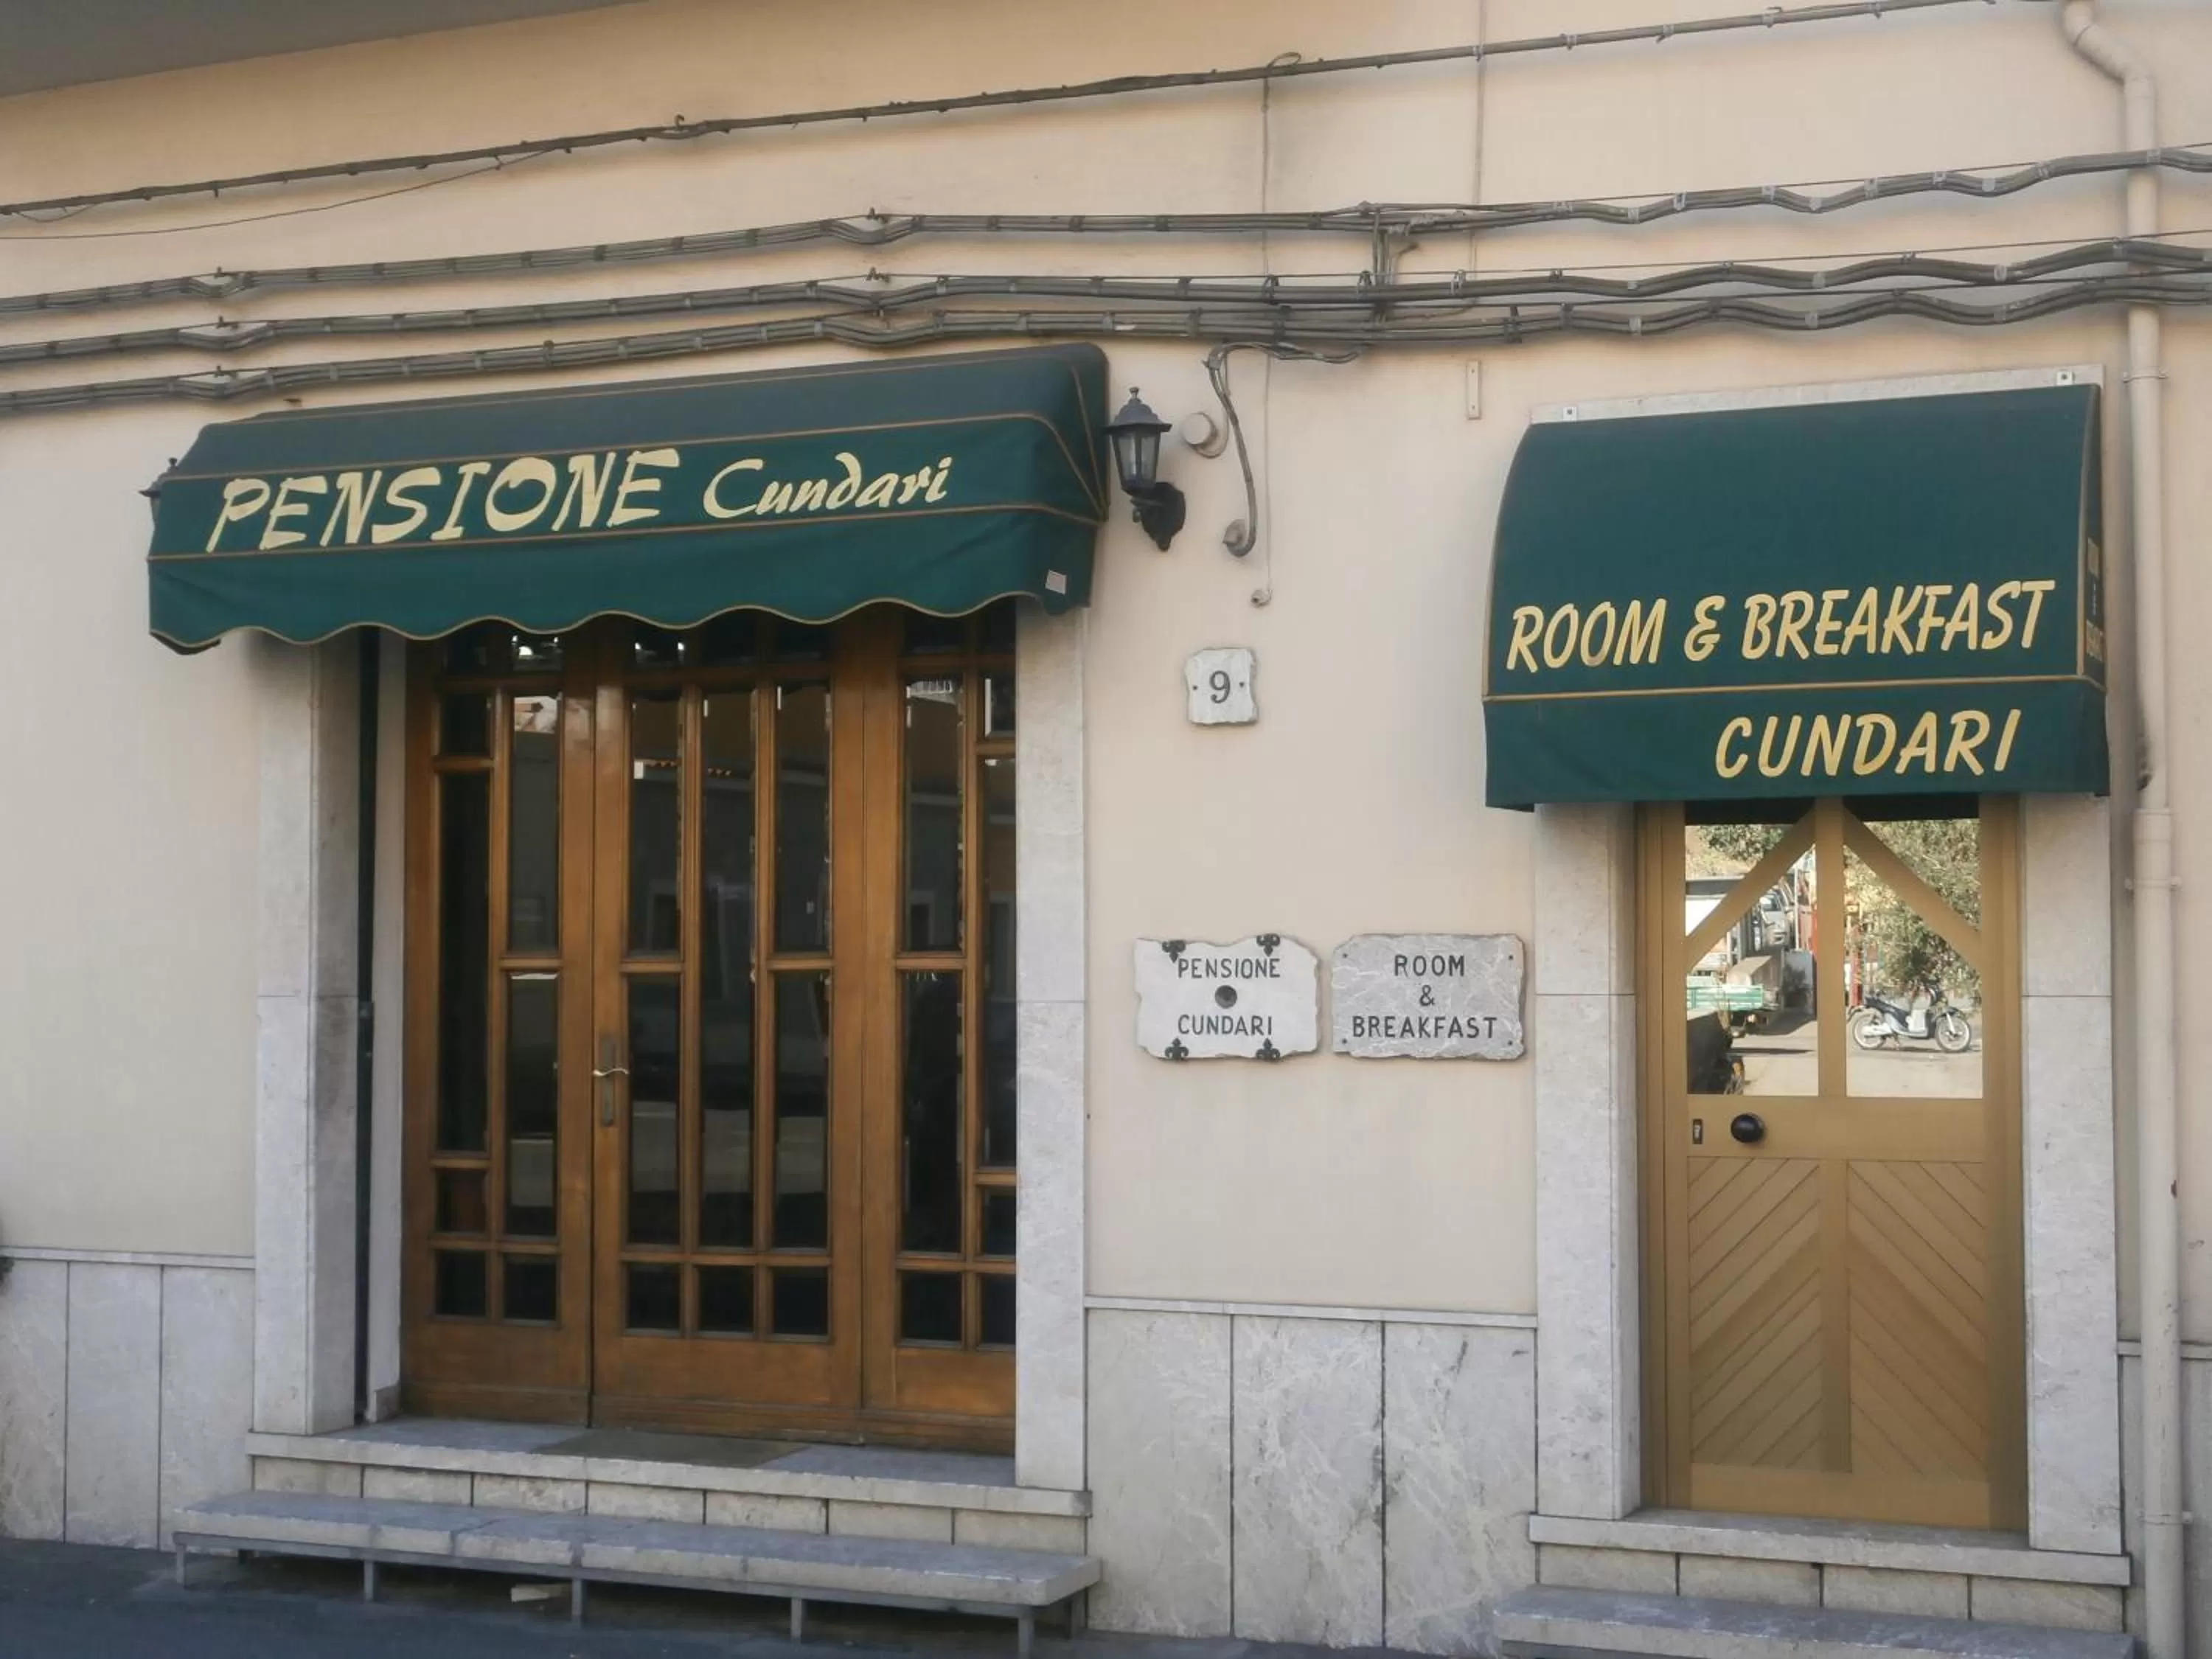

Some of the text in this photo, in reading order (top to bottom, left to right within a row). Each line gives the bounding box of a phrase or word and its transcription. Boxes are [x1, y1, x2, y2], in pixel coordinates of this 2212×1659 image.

[207, 449, 952, 552] PENSIONE Cundari
[1506, 599, 1666, 672] ROOM
[1684, 596, 1725, 661] &
[1742, 580, 2055, 659] BREAKFAST
[1209, 670, 1231, 704] 9
[1716, 709, 2021, 778] CUNDARI
[1178, 958, 1281, 979] PENSIONE
[1394, 954, 1466, 977] ROOM
[1419, 984, 1436, 1007] &
[1178, 1014, 1273, 1036] CUNDARI
[1352, 1015, 1498, 1039] BREAKFAST
